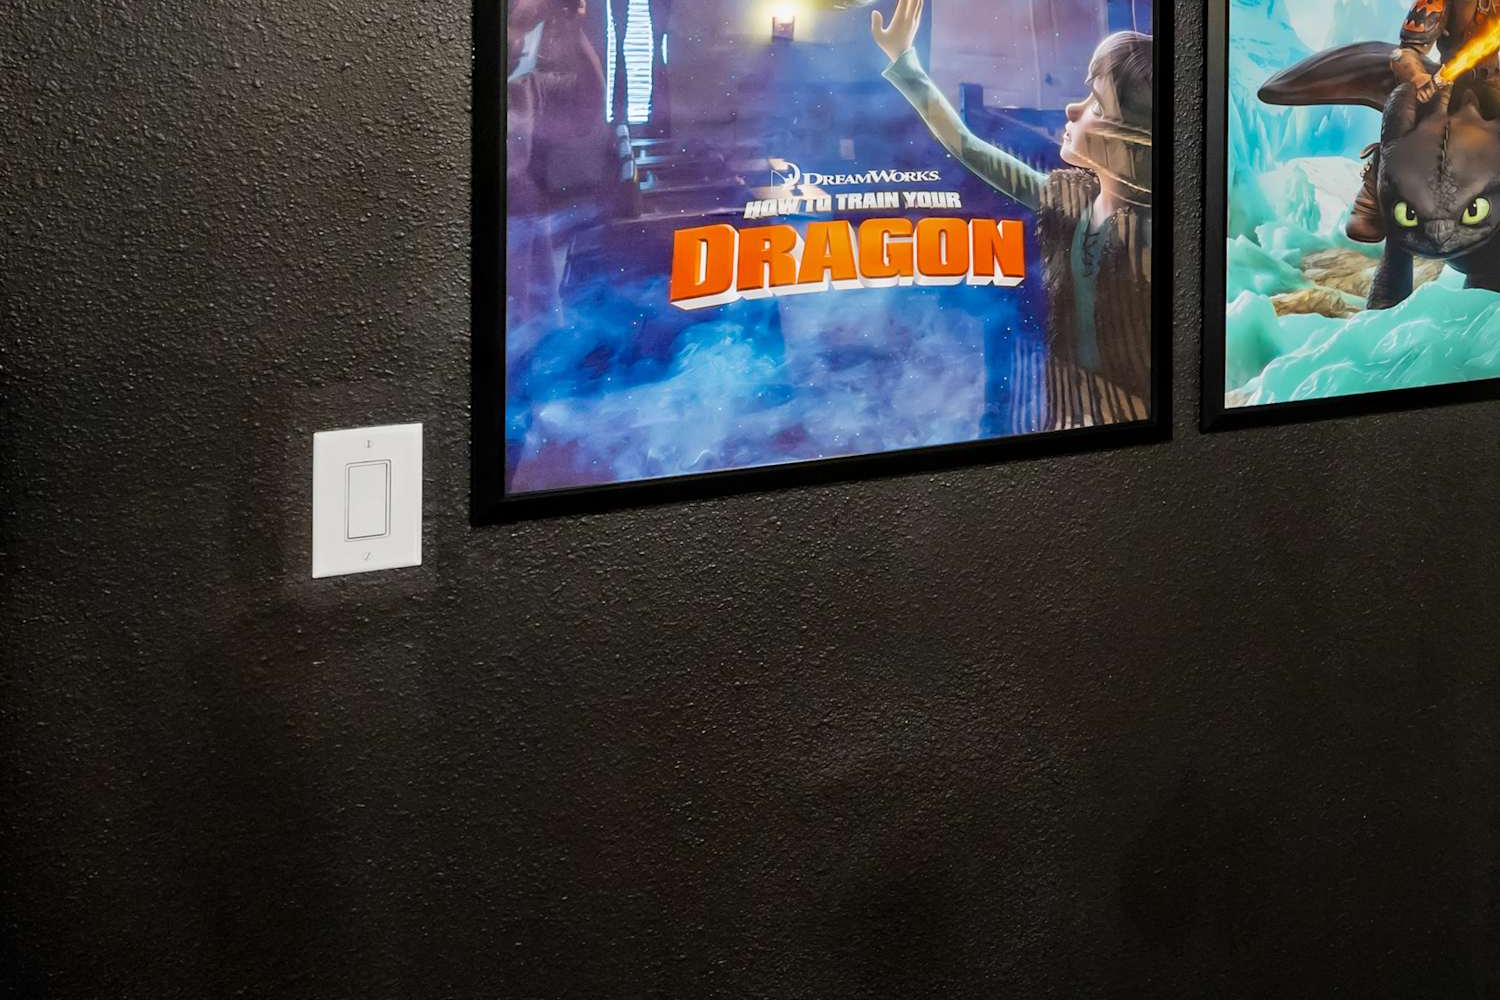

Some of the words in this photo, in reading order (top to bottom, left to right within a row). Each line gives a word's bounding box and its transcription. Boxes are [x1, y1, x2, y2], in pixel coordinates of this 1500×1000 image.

[743, 199, 800, 220] HOW
[805, 194, 833, 213] TO
[836, 191, 900, 210] TRAIN
[902, 190, 962, 209] YOUR
[670, 217, 1025, 309] DRAGON
